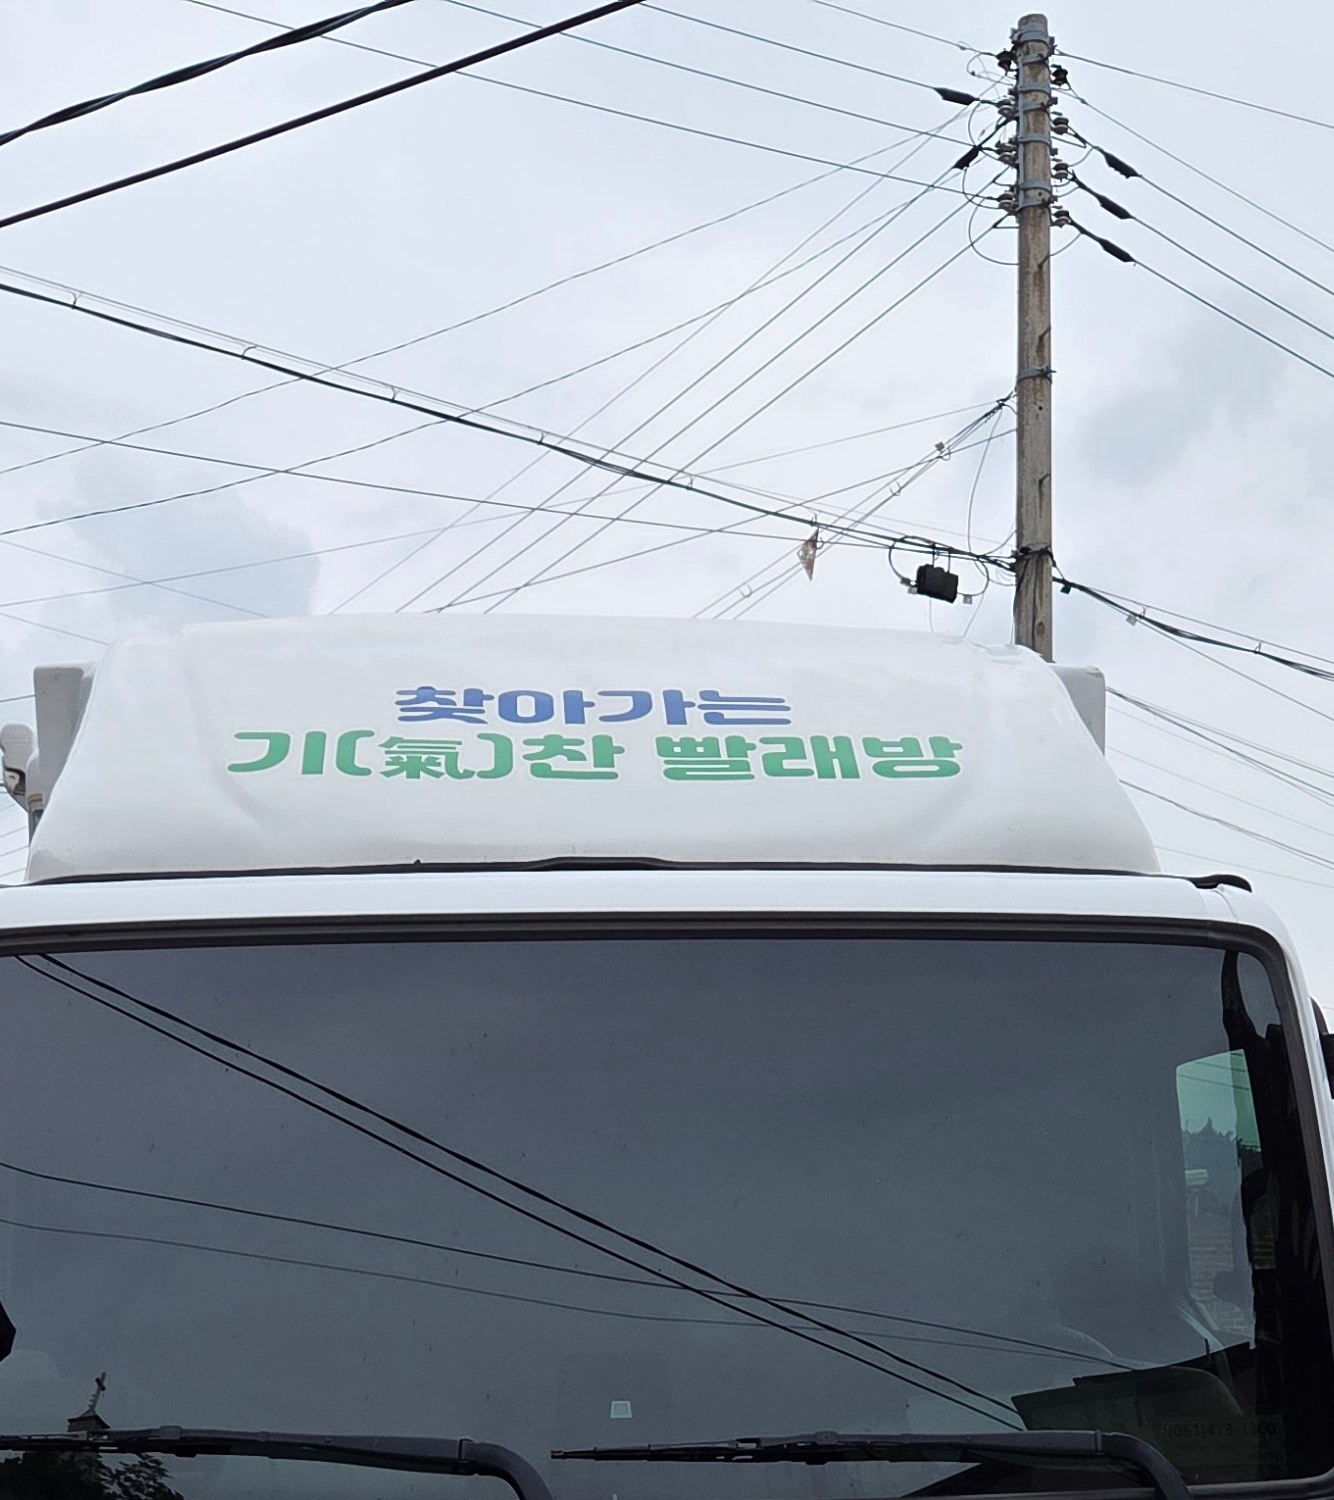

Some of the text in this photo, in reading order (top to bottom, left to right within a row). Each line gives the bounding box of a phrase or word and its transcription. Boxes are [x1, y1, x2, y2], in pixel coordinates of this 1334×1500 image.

[394, 685, 792, 726] 찾아가는
[226, 729, 966, 782] 기(氣)찬 빨래방
